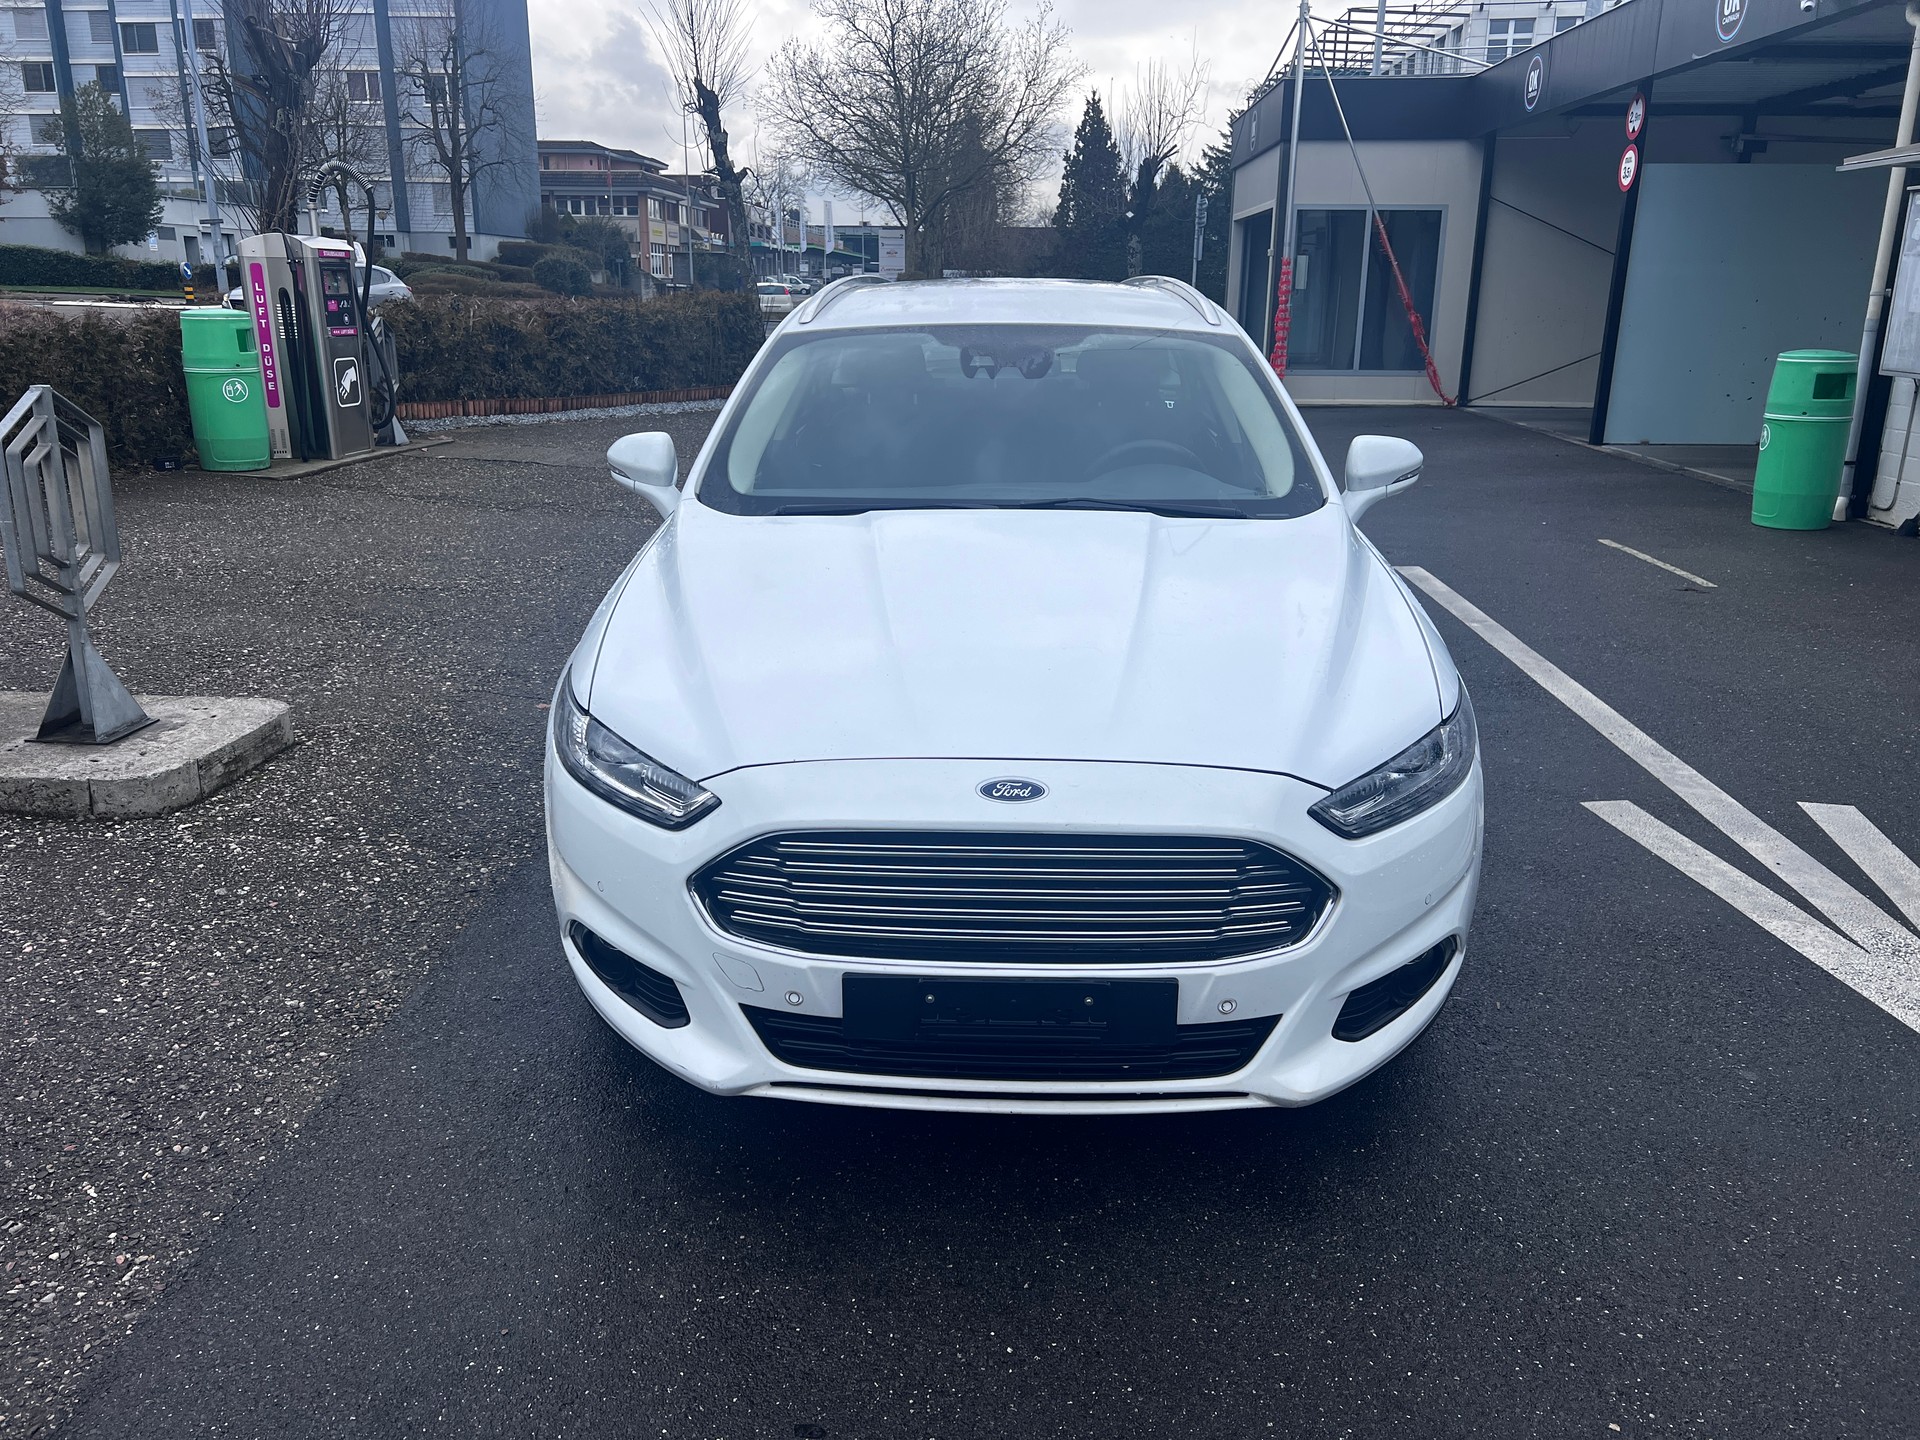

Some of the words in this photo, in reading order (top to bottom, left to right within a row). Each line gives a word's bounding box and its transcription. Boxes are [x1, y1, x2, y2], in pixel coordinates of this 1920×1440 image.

[1529, 69, 1540, 92] OK
[255, 282, 267, 328] LUFT
[263, 343, 276, 391] DÜSE
[992, 782, 1032, 797] Ford
